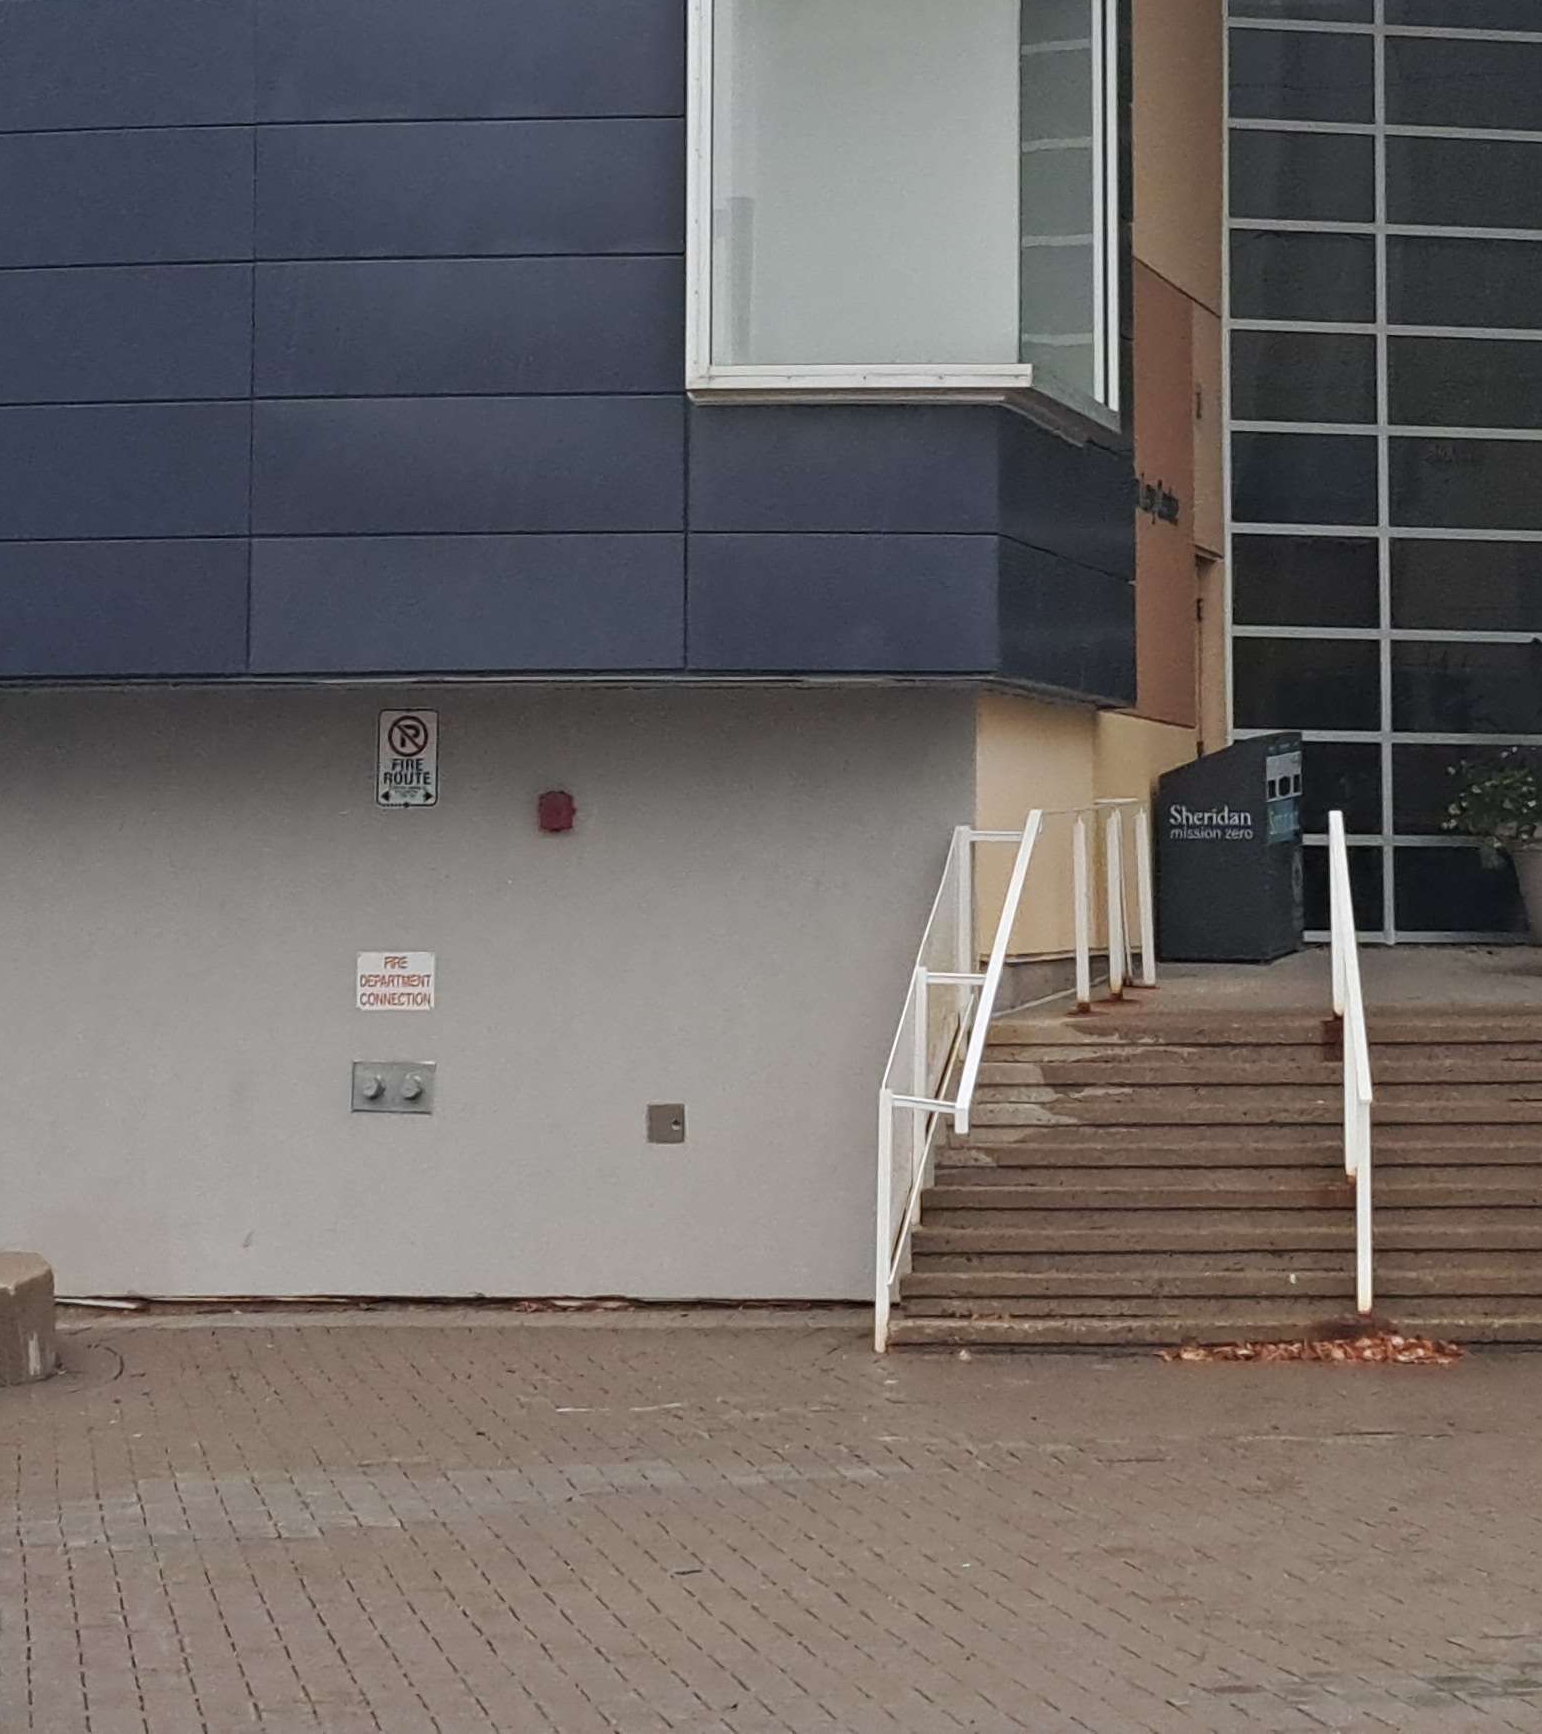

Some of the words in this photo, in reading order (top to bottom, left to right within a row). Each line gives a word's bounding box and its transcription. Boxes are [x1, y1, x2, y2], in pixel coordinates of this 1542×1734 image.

[392, 758, 424, 771] FIRE
[383, 771, 431, 785] ROUTE
[1169, 804, 1252, 826] Sheridan
[1170, 827, 1221, 840] mission
[1225, 828, 1254, 840] zero
[384, 956, 408, 969] FIRE
[360, 974, 431, 987] DEPARTMENT
[360, 992, 431, 1006] CONNECTION
